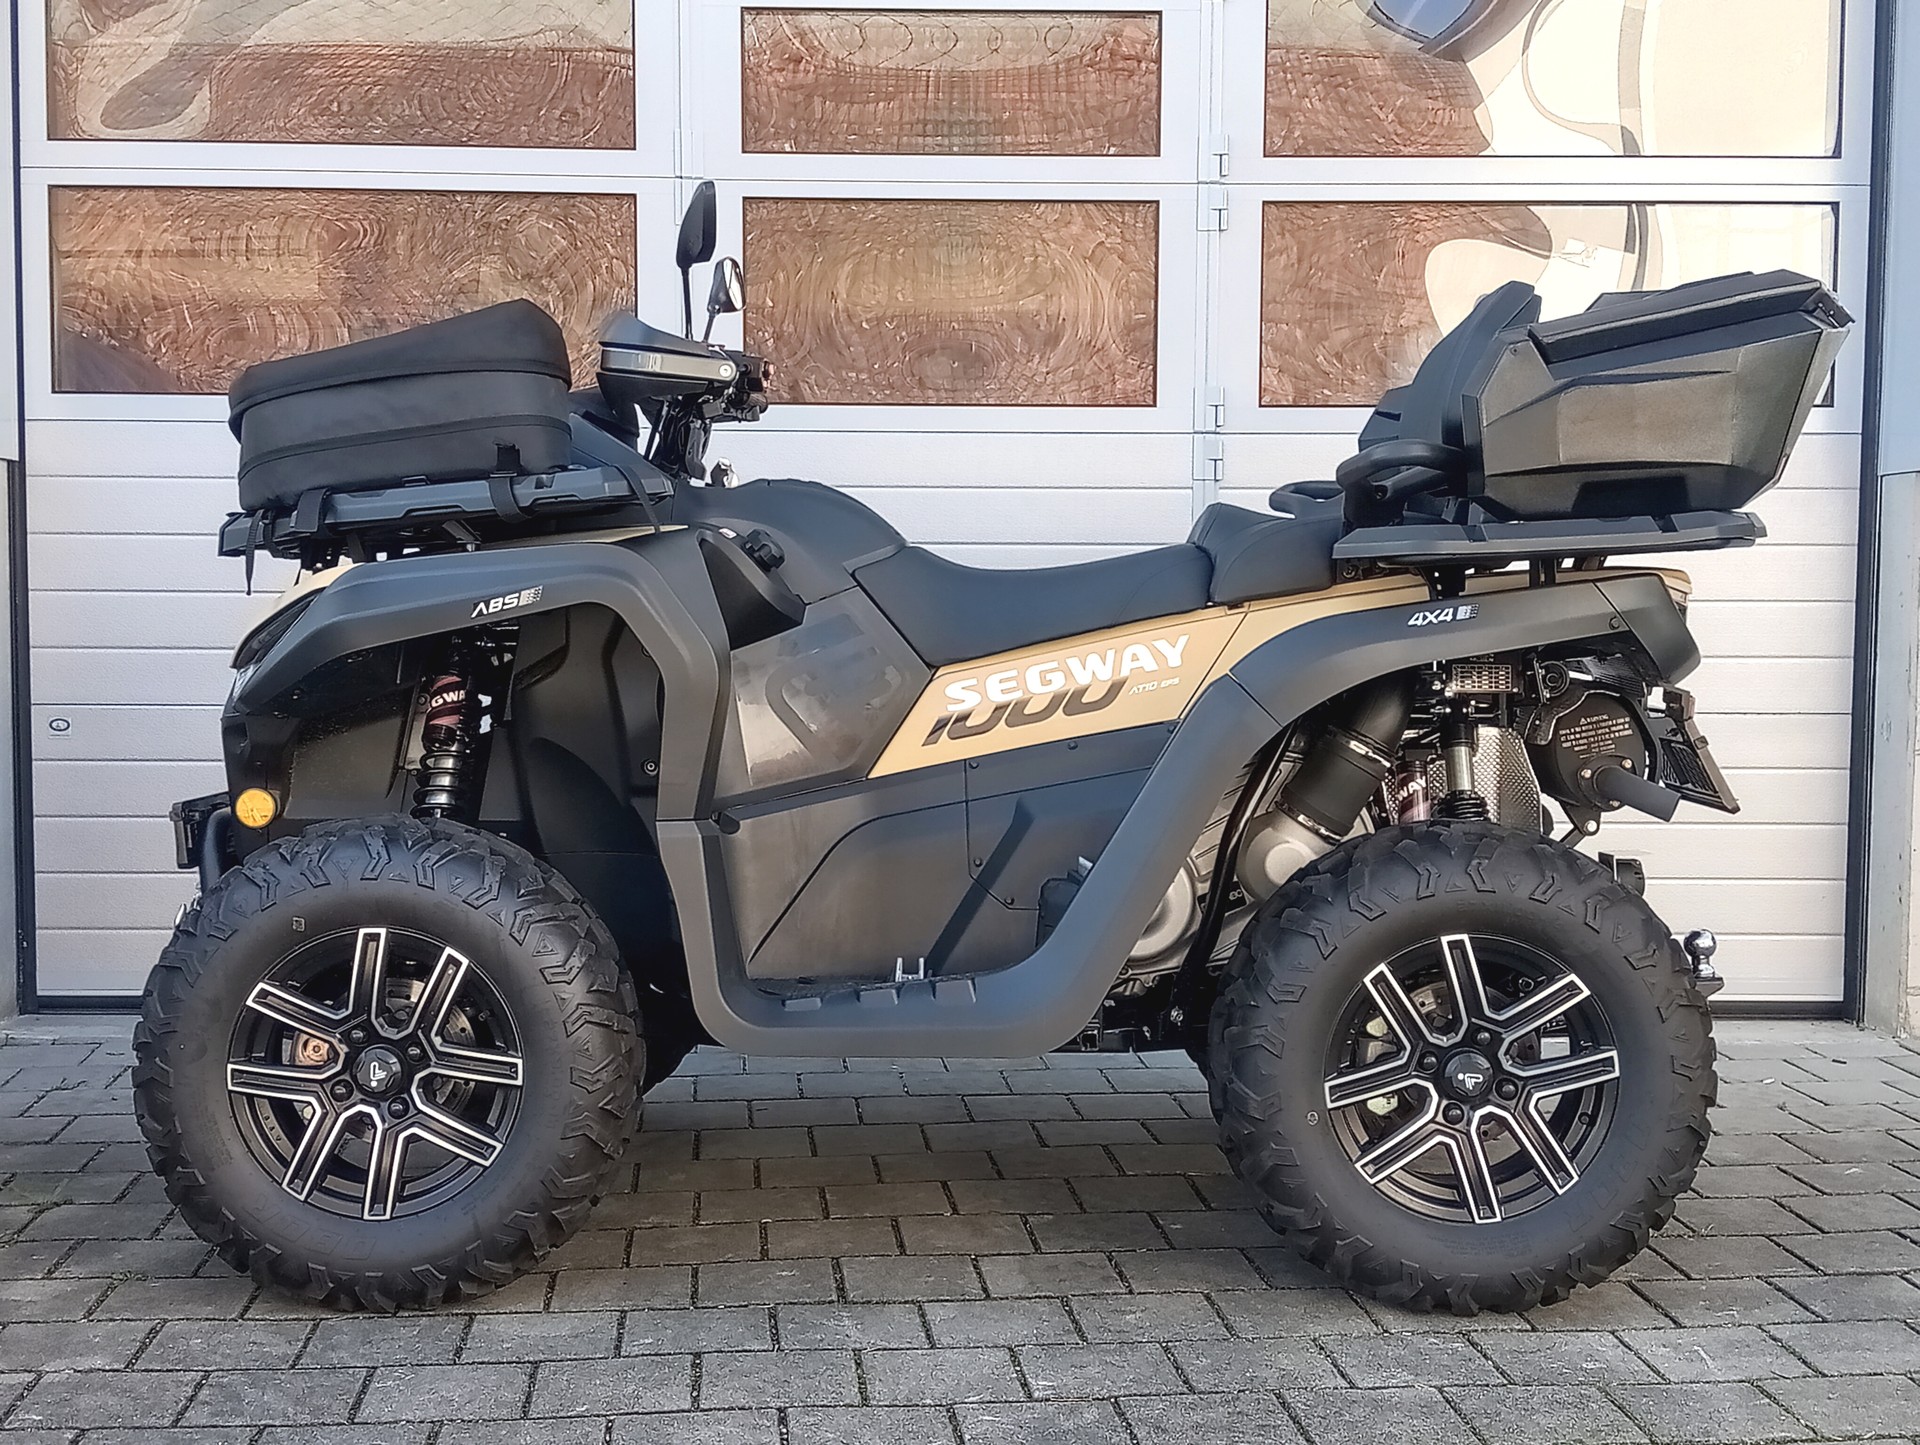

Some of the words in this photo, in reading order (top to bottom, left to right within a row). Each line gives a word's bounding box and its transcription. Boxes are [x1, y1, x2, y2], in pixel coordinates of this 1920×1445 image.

[470, 592, 520, 619] ABS
[944, 634, 1190, 713] SEGWAY
[1128, 681, 1158, 695] AT10
